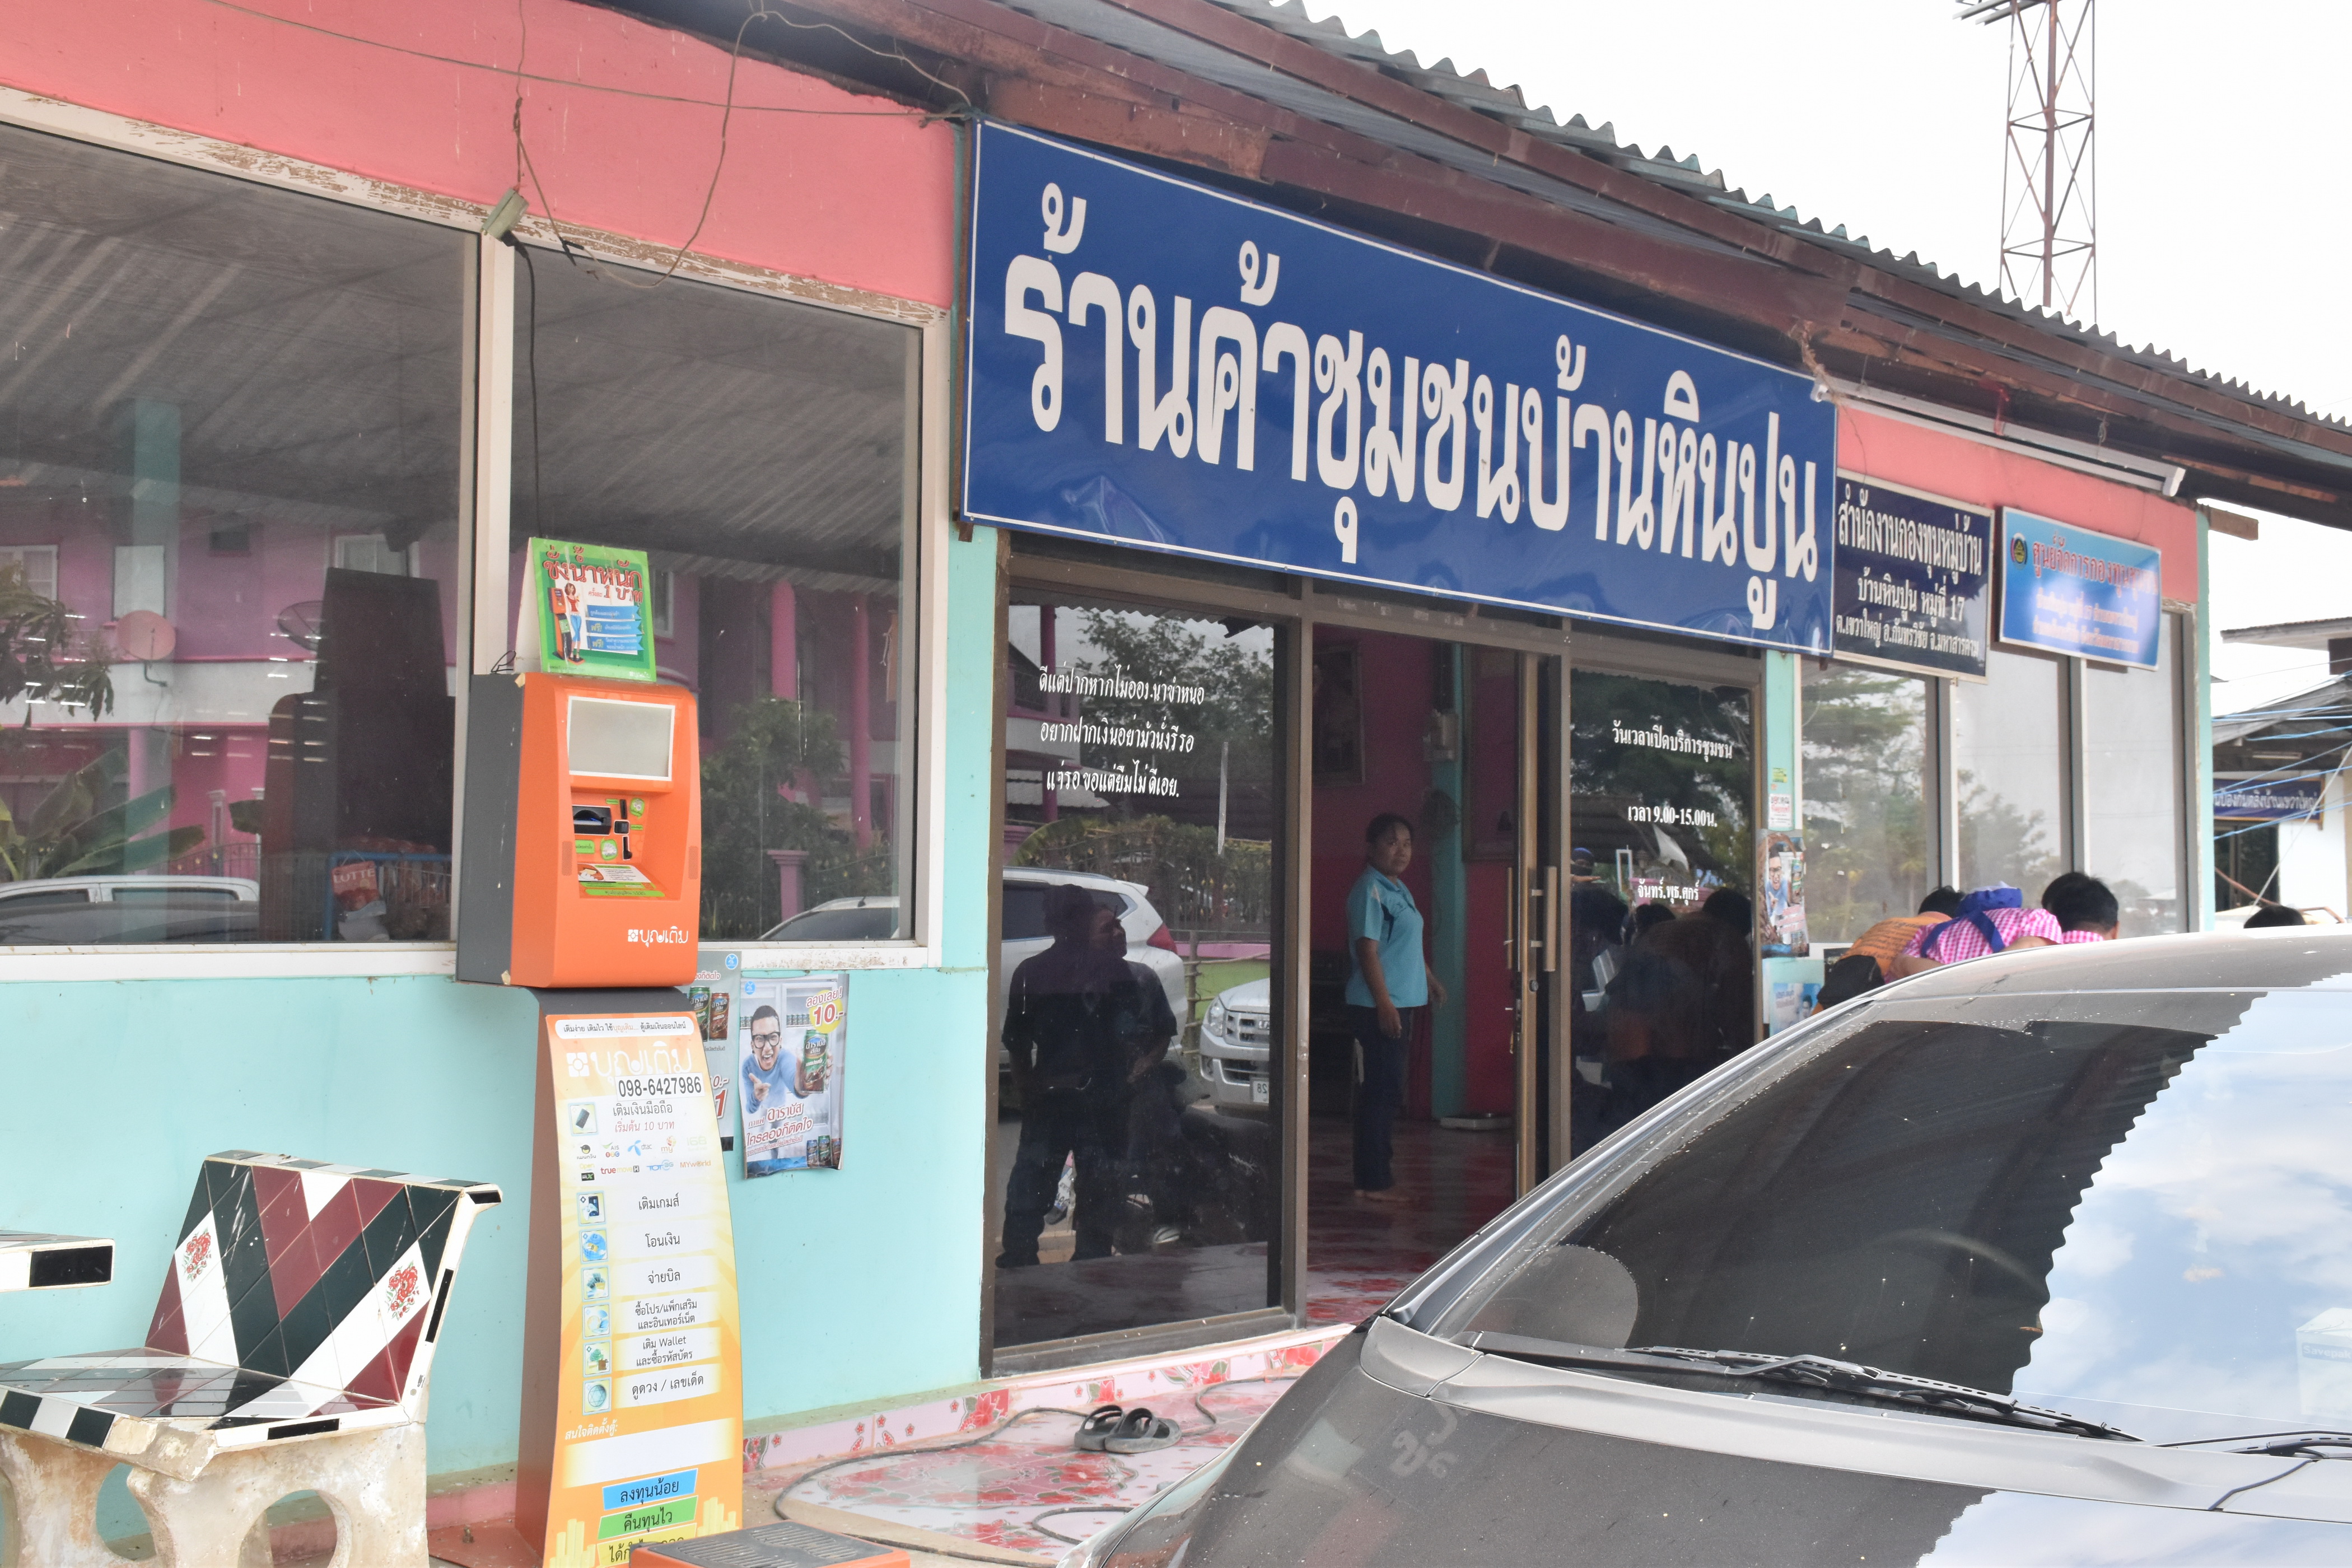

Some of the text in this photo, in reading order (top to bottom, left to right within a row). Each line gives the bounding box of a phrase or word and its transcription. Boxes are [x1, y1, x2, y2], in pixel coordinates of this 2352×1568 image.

[1005, 183, 1818, 630] ร้านค้าชุมชนบ้านหินปูน
[1838, 483, 1982, 584] สำนักงานกองทุนหมู่บ้าน
[543, 544, 643, 589] ชั่งน้ำหนัก
[1858, 566, 1965, 627] บ้านหินปูน หมู่ที่ 17
[1612, 720, 1733, 762] วันเวลาเปิดบริการชุมชน
[1628, 806, 1651, 822] เวลา
[639, 926, 689, 948] บุญเติม
[618, 1076, 702, 1098] 098-6427986
[613, 1099, 673, 1117] เติมเงินมือถือ
[615, 1118, 675, 1133] เริ่มต้น 10 บาท
[638, 1192, 680, 1210] เติมเกมส์
[645, 1232, 680, 1248] โอนเงิน
[648, 1269, 681, 1284] จ่ายบิล
[638, 1313, 696, 1330] และอินเทอร์เน็ต
[643, 1336, 687, 1350] เติม Wallet
[636, 1349, 693, 1366] และซื้อรหัสบัตร
[632, 1382, 657, 1399] ดูดวง
[670, 1371, 704, 1389] เลขเด็ด
[620, 1478, 679, 1504] ลงทุนน้อย
[624, 1507, 673, 1533] คืนทุนไว
